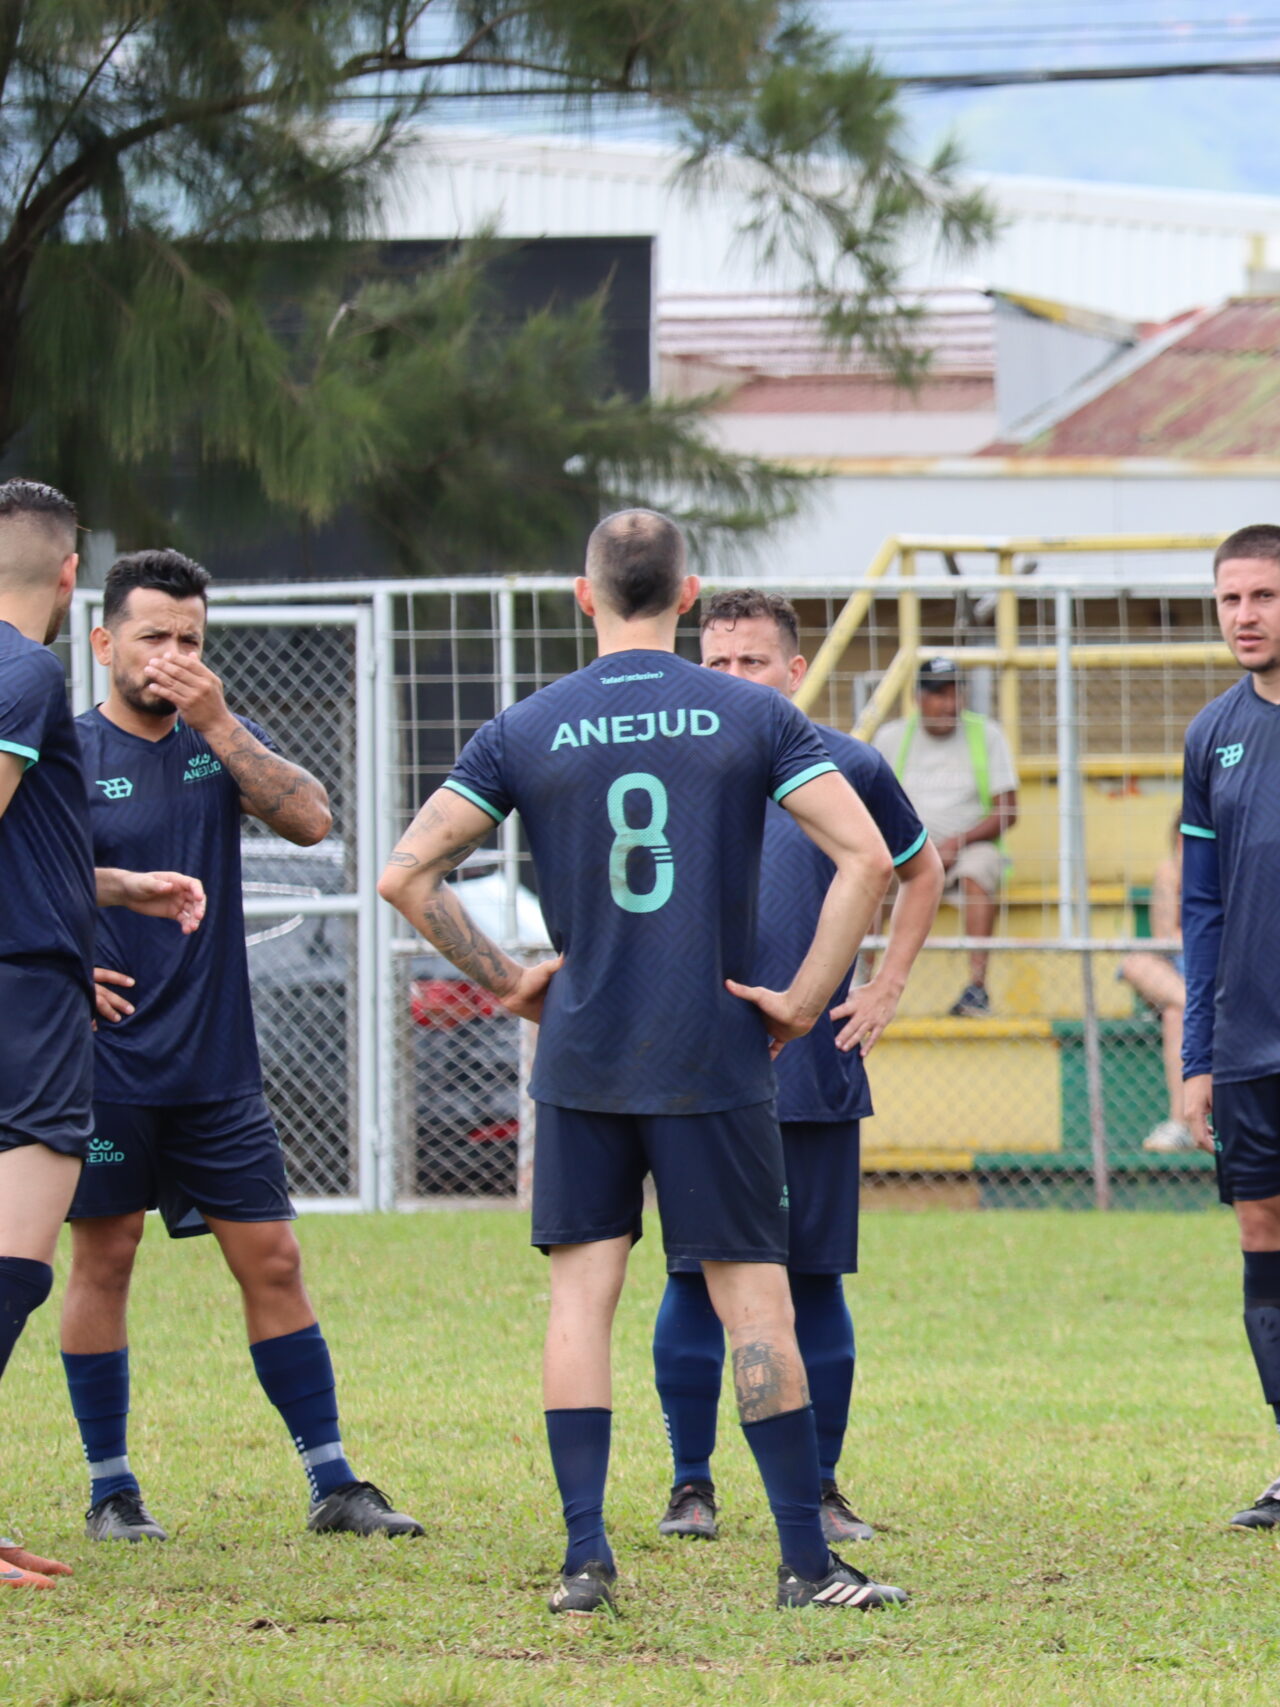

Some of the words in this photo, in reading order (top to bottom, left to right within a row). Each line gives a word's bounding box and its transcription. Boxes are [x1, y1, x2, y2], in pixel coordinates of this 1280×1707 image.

[550, 708, 721, 751] ANEJUD
[606, 772, 676, 914] 8
[86, 1151, 126, 1164] EJUD
